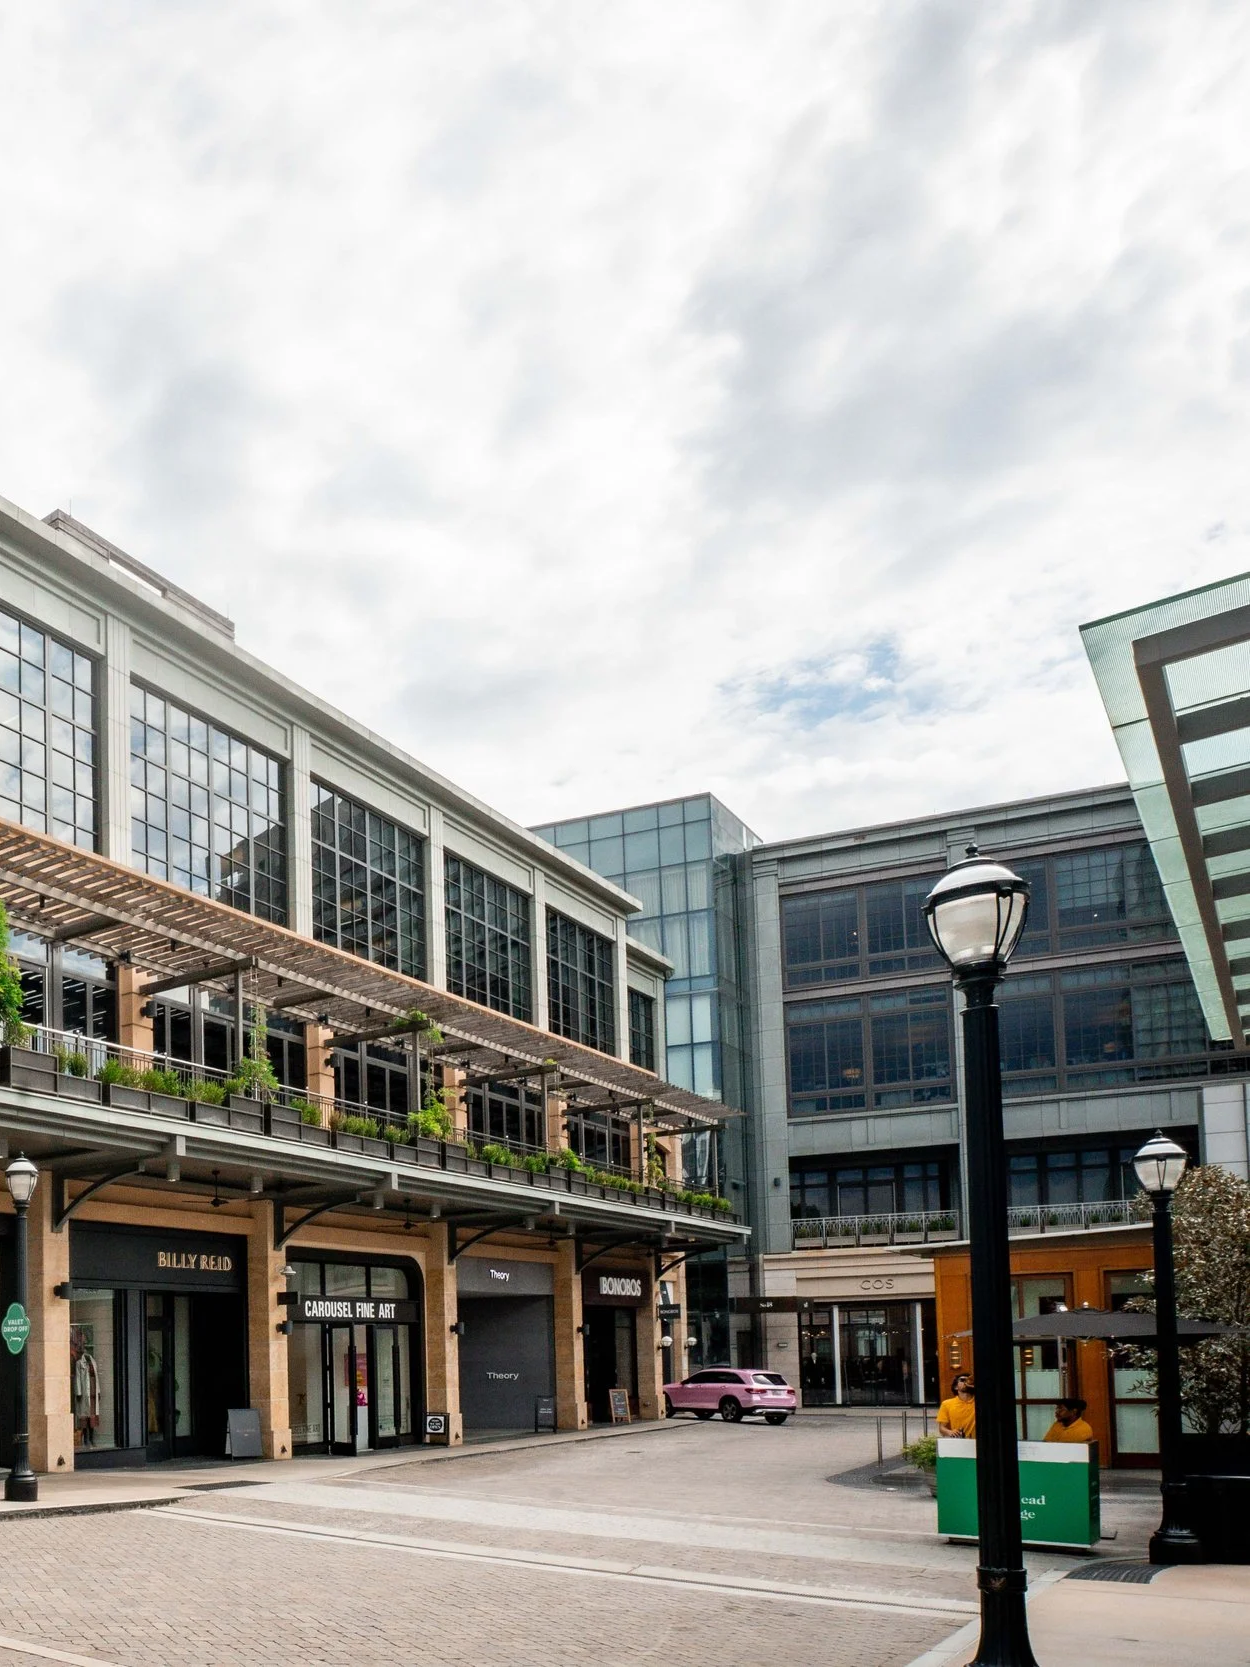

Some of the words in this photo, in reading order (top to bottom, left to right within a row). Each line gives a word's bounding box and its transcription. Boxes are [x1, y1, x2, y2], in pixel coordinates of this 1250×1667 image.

[157, 1251, 197, 1269] BILLY
[199, 1254, 232, 1271] REID
[489, 1269, 510, 1282] Theory
[599, 1276, 642, 1297] BONOBOS
[860, 1278, 894, 1290] COS
[304, 1300, 353, 1318] CAROUSEL
[355, 1301, 375, 1319] FINE
[378, 1302, 396, 1319] ART
[486, 1371, 520, 1381] Theory
